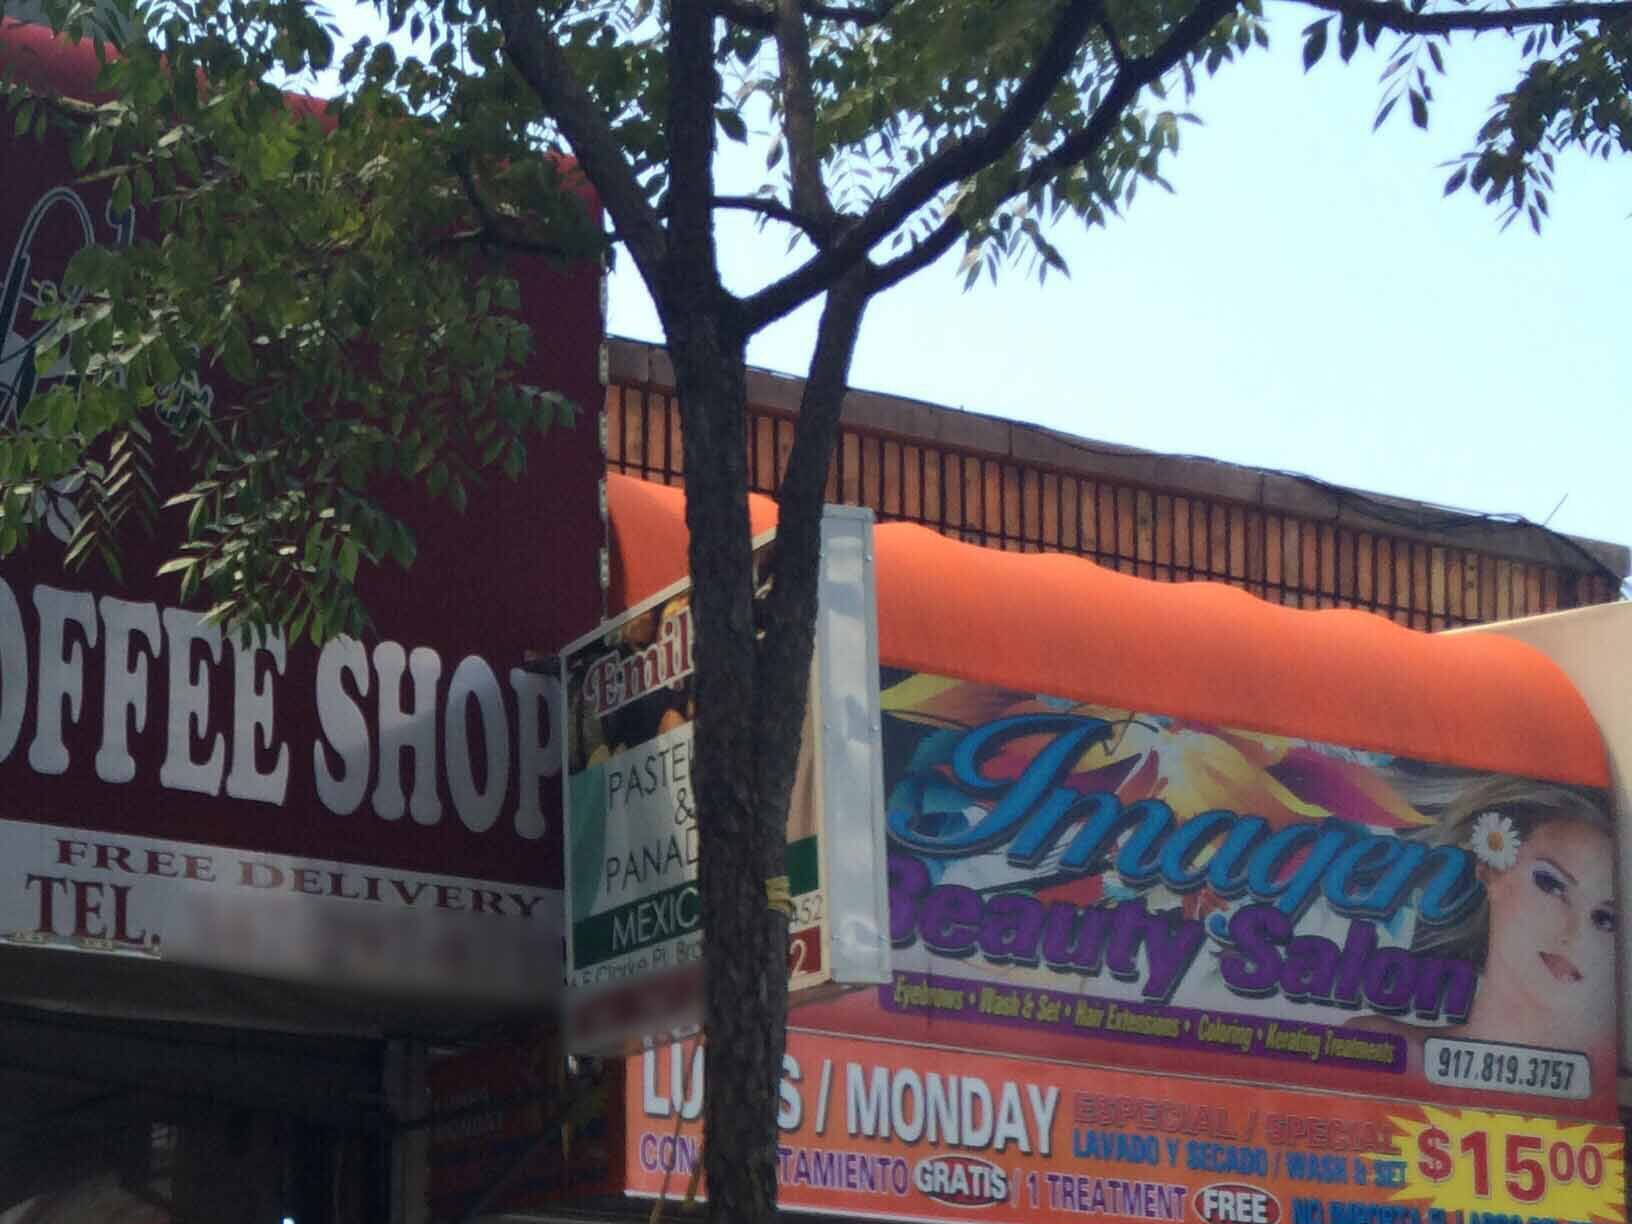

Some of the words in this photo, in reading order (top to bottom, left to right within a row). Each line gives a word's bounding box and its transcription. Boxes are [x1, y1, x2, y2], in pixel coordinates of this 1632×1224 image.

[580, 606, 696, 718] Emil
[314, 634, 564, 840] SHOP
[888, 712, 1485, 927] Imagen
[25, 873, 161, 945] TEL.
[56, 839, 218, 883] FREE
[238, 860, 544, 918] DELIVERY
[611, 887, 700, 952] MEXIC
[1218, 903, 1469, 1028] Salon
[1437, 1046, 1576, 1092] 917.819.3757
[846, 1062, 1061, 1157] MONDAY
[913, 1160, 1009, 1200] GRATIS
[1048, 1173, 1187, 1224] TREATMENT
[1071, 1129, 1160, 1168] LAVADO
[1185, 1139, 1270, 1179] SECADO
[1286, 1151, 1348, 1185] WASH
[1370, 1160, 1409, 1190] SET
